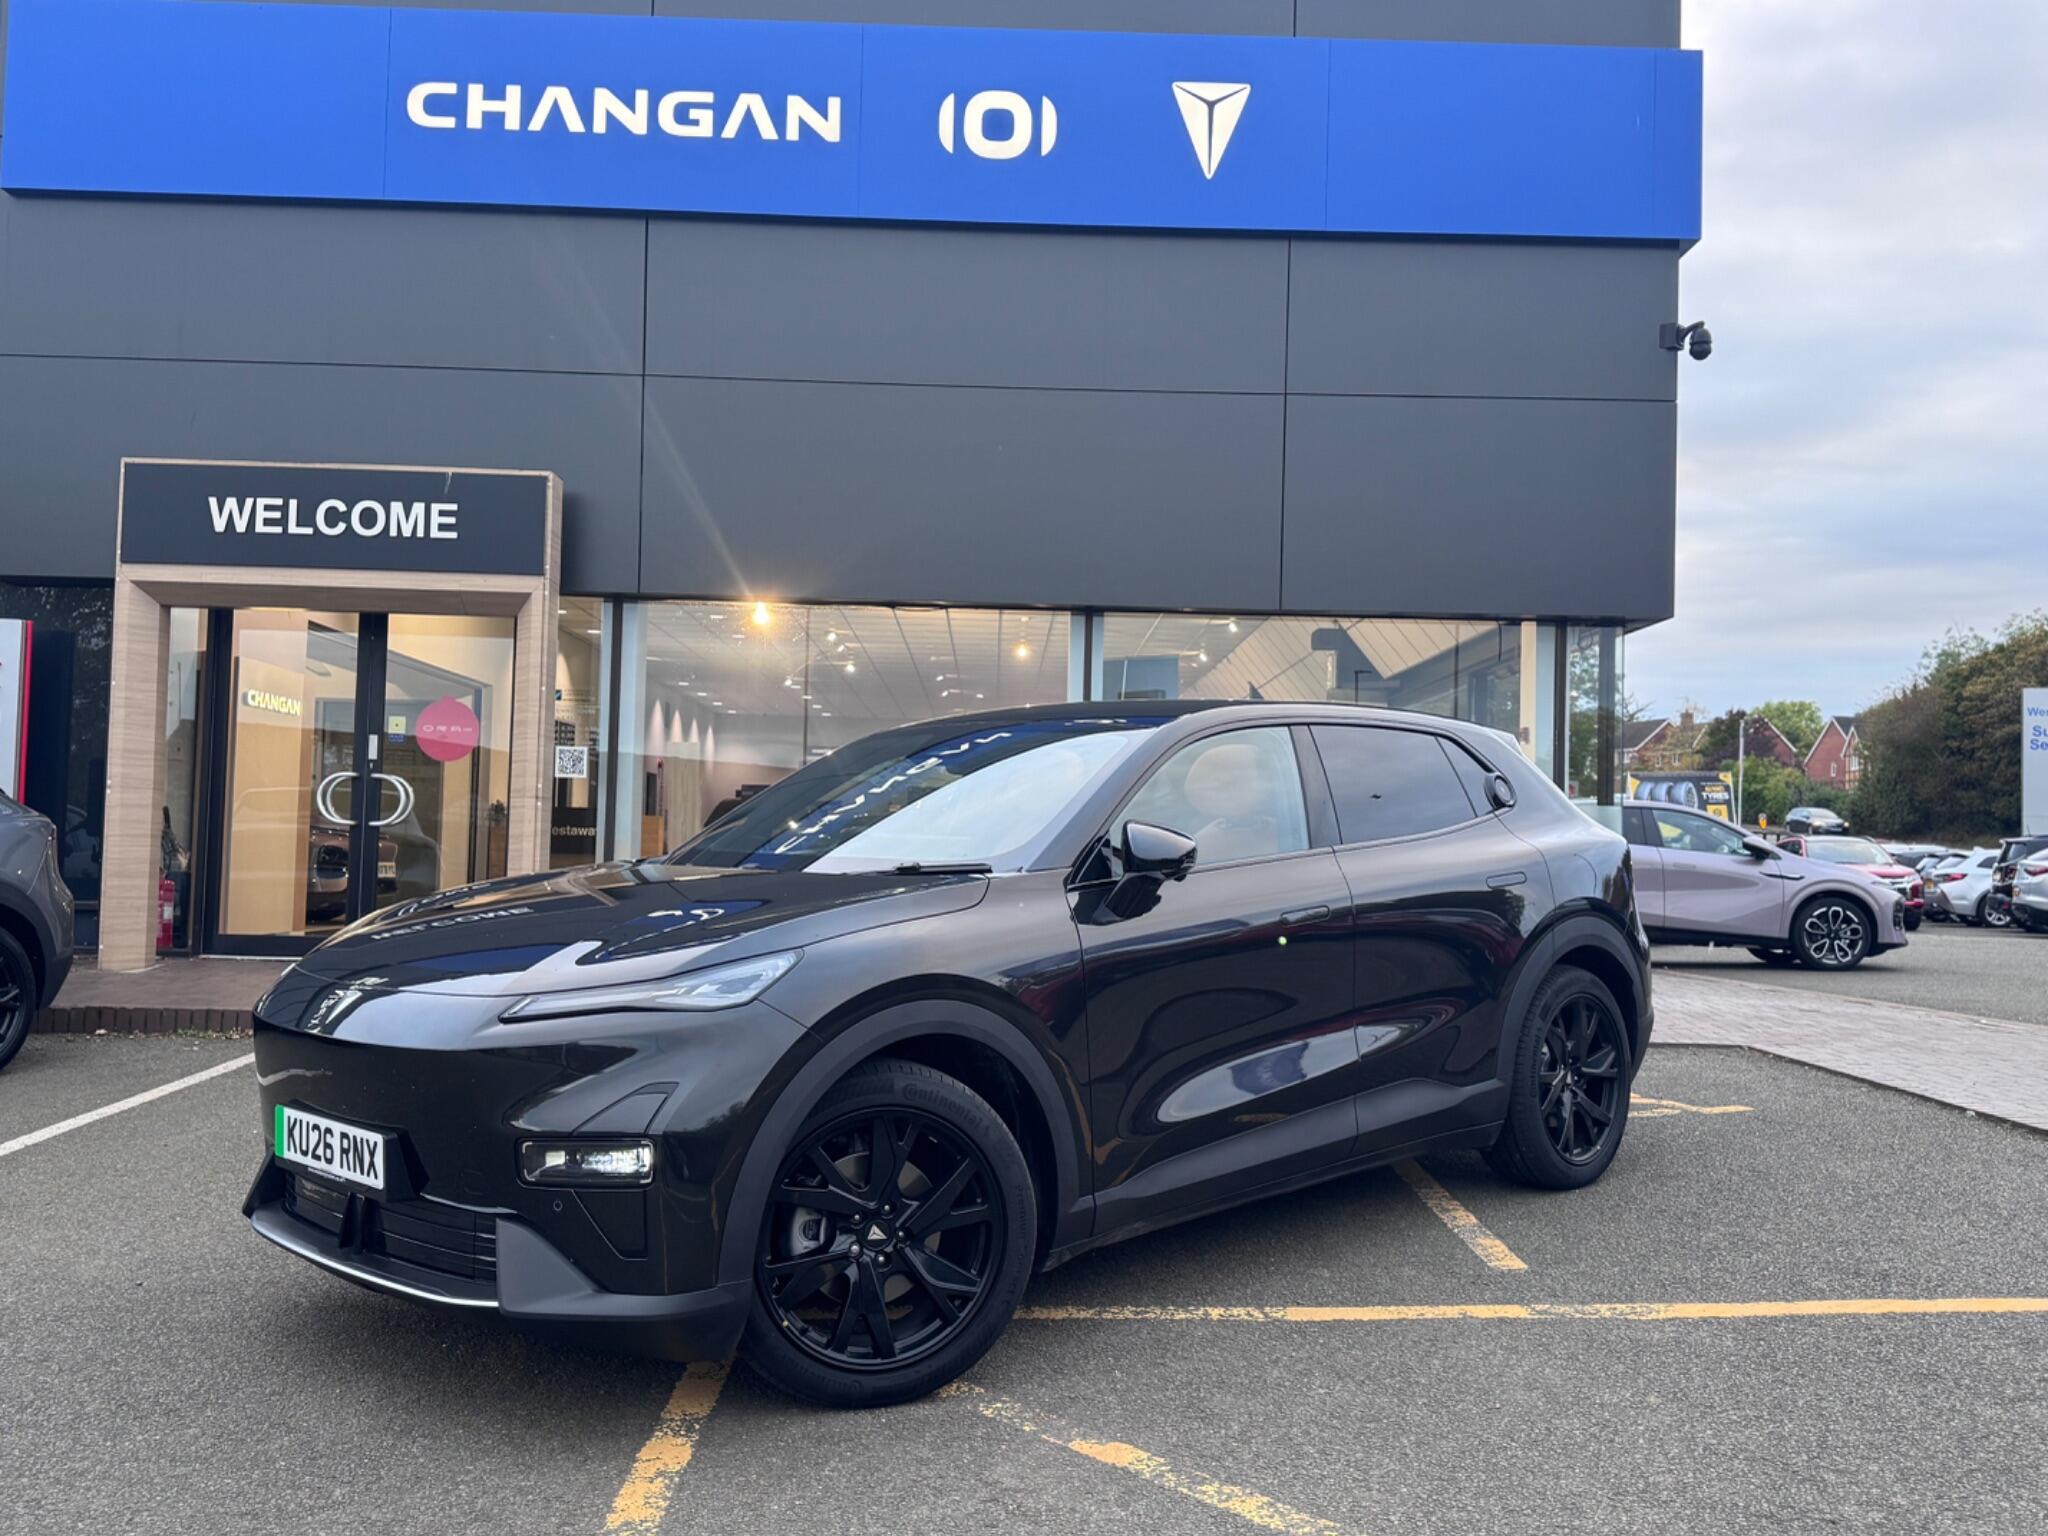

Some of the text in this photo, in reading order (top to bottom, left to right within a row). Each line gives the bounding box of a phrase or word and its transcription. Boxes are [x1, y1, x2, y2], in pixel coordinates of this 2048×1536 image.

[406, 81, 841, 143] CHANGAN
[208, 496, 459, 539] WELCOME
[247, 688, 302, 717] CHANGAN
[551, 825, 597, 836] estawa
[287, 1115, 378, 1180] KU26 RNX
